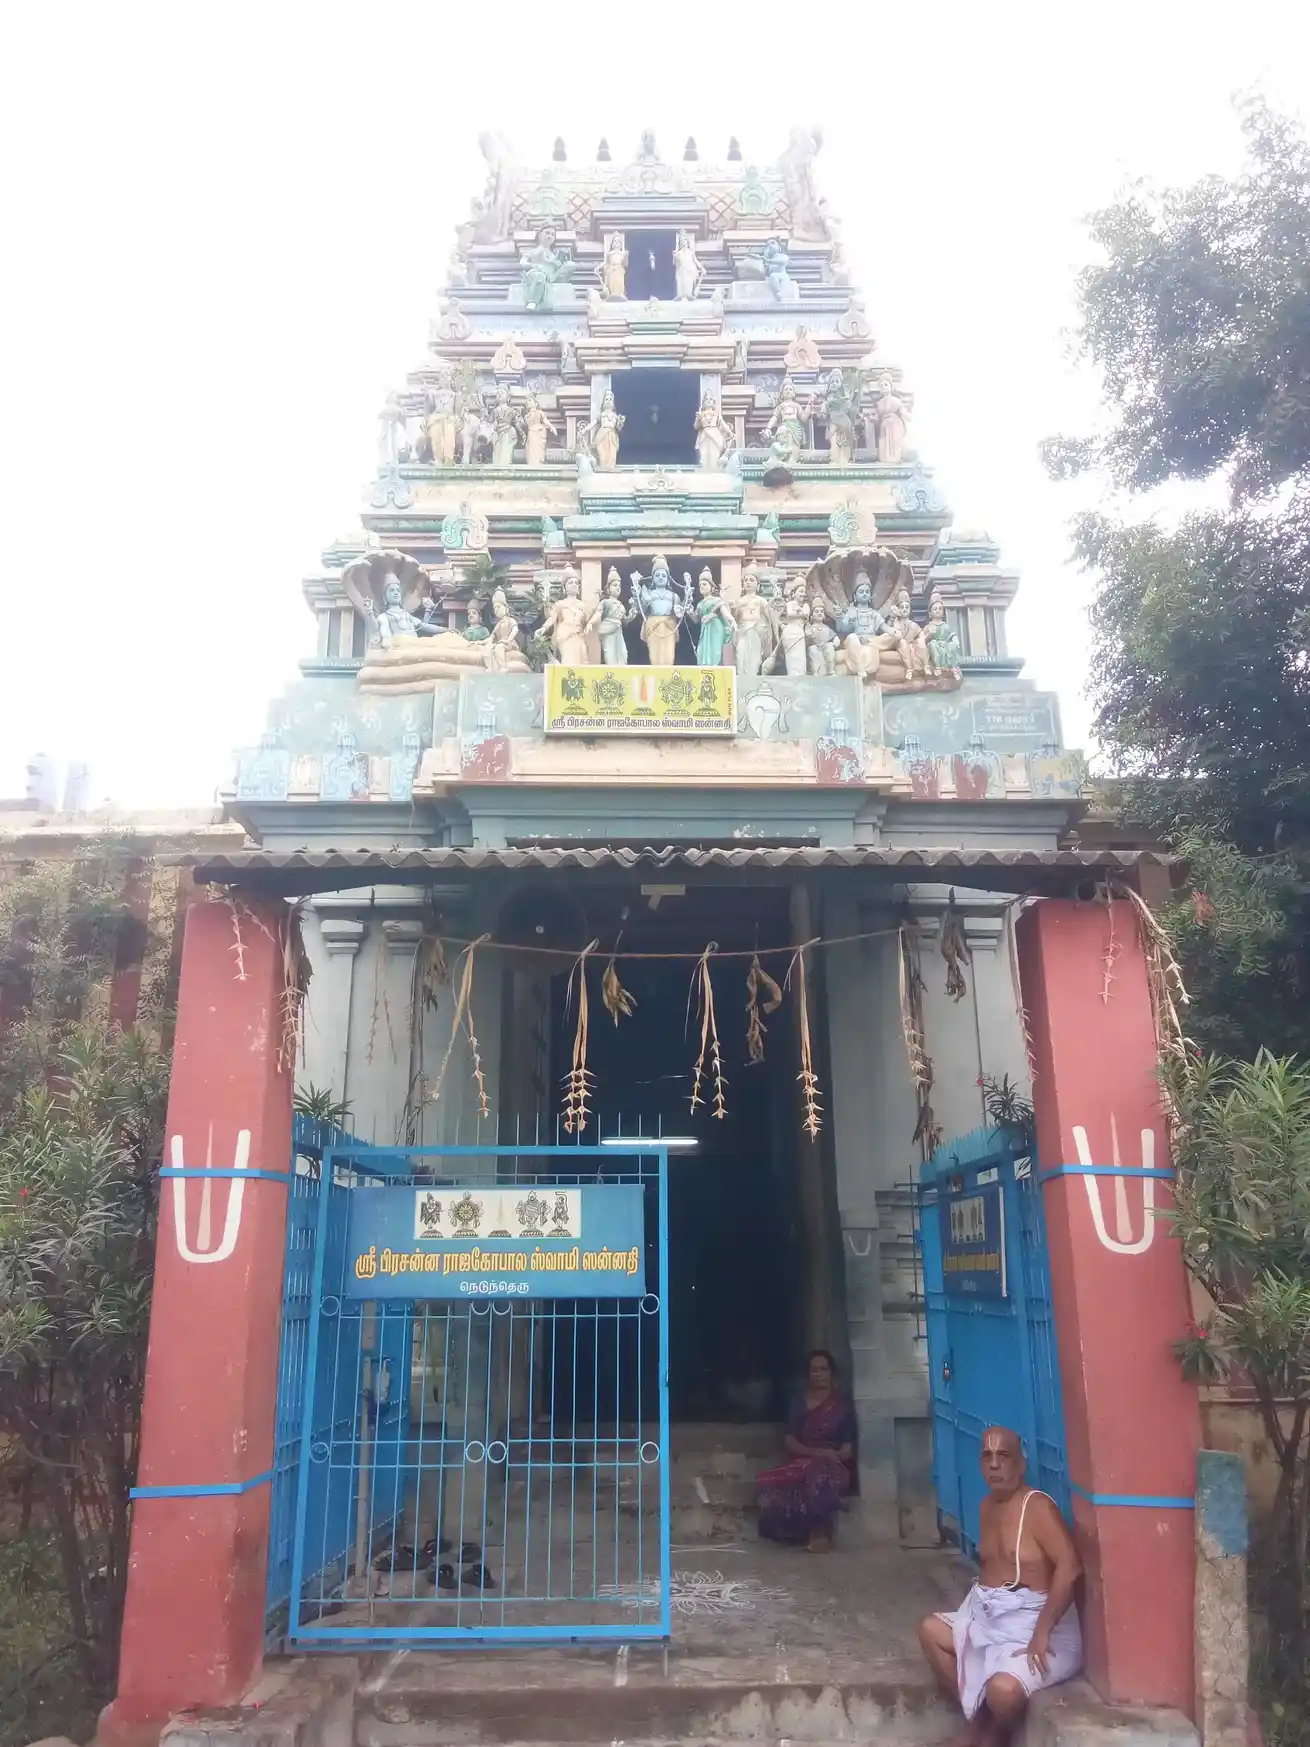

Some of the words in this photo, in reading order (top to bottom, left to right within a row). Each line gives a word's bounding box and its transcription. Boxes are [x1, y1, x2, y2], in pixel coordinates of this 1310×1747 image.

[567, 716, 605, 728] பிரசன்ன
[607, 717, 660, 728] ராஜகோபால
[661, 716, 694, 728] ஸ்வாமி
[695, 717, 732, 730] ஸன்னதி
[379, 1247, 440, 1276] பிரசன்ன
[443, 1246, 528, 1275] ராஜகோபால
[530, 1246, 580, 1271] ஸ்வாமி
[582, 1246, 640, 1276] ஸன்னதி
[459, 1280, 530, 1295] நெடுந்தெரு
